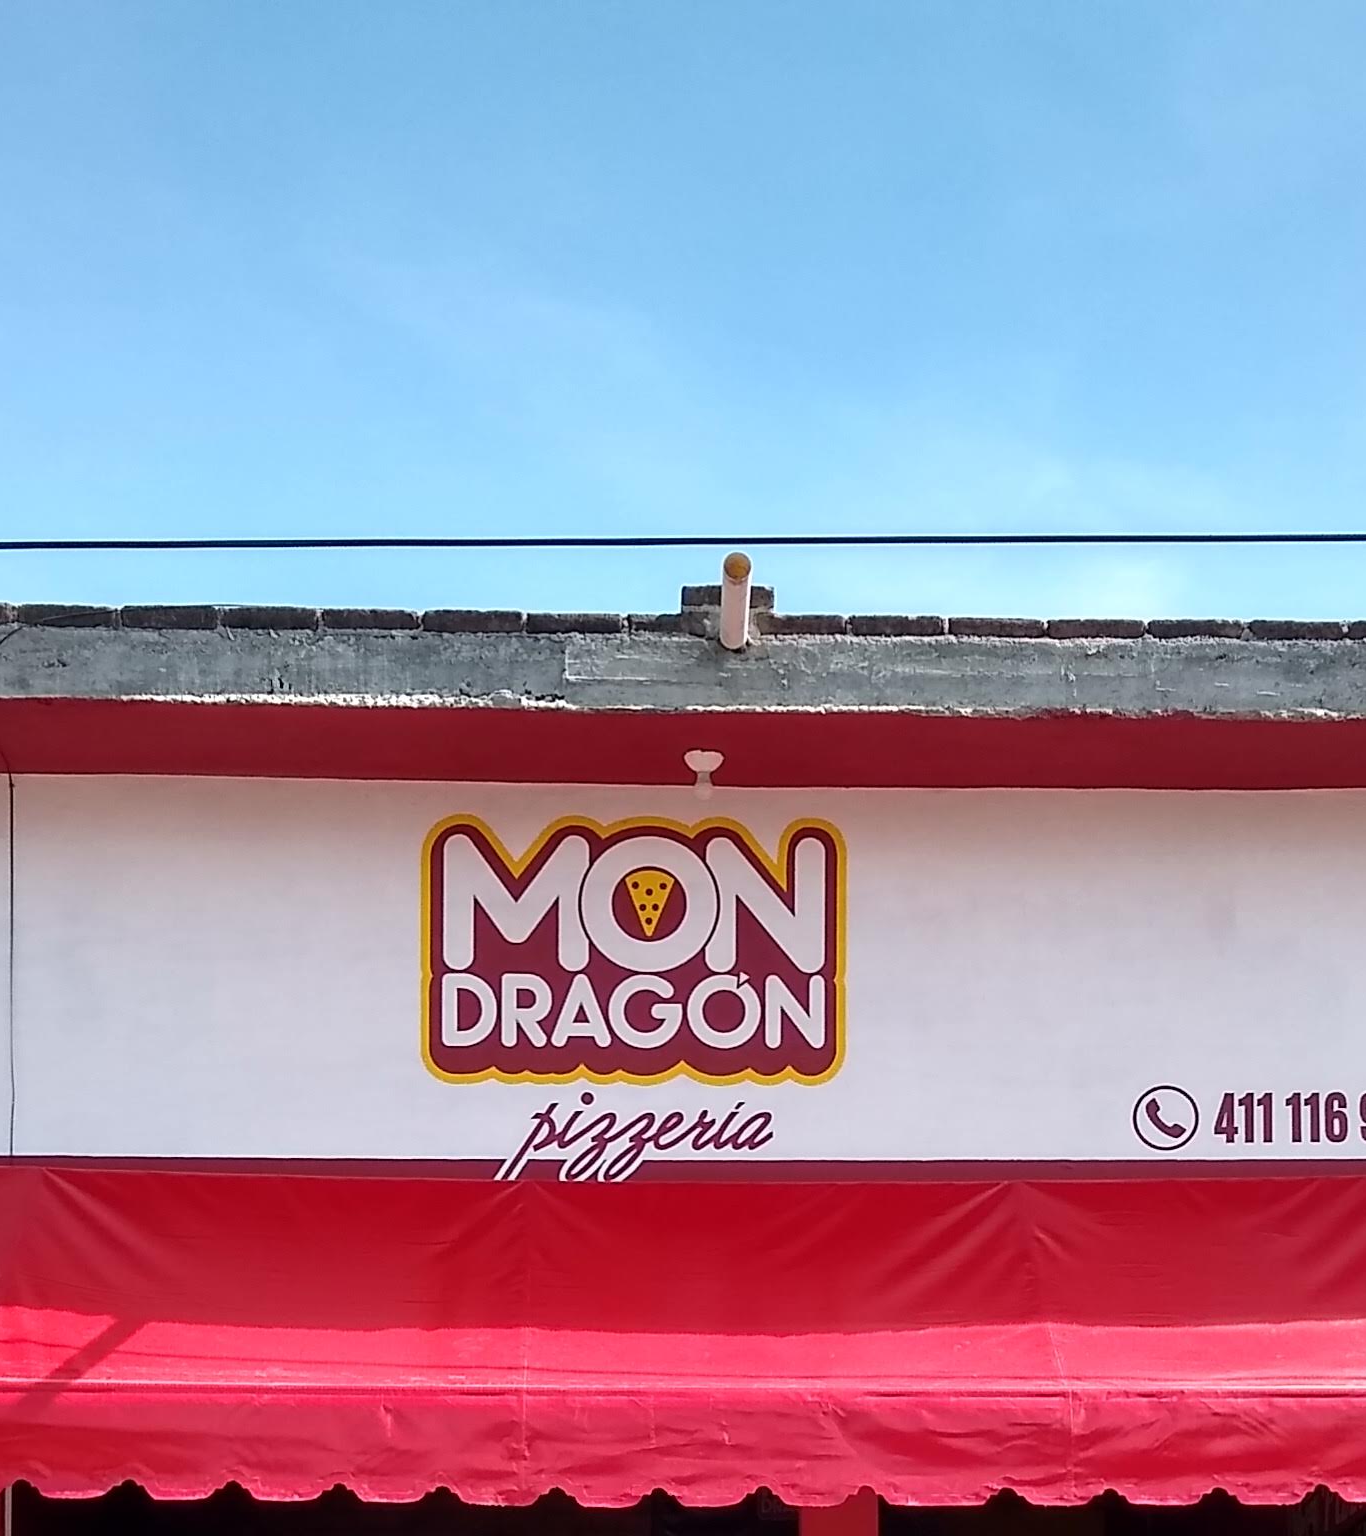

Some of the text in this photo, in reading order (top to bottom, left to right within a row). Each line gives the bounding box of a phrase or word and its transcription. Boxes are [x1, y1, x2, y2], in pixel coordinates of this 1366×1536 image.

[443, 833, 826, 973] MON
[441, 971, 825, 1049] DRAGÓN
[494, 1092, 774, 1181] pizzería
[1214, 1091, 1274, 1144] 411
[1285, 1091, 1348, 1144] 116
